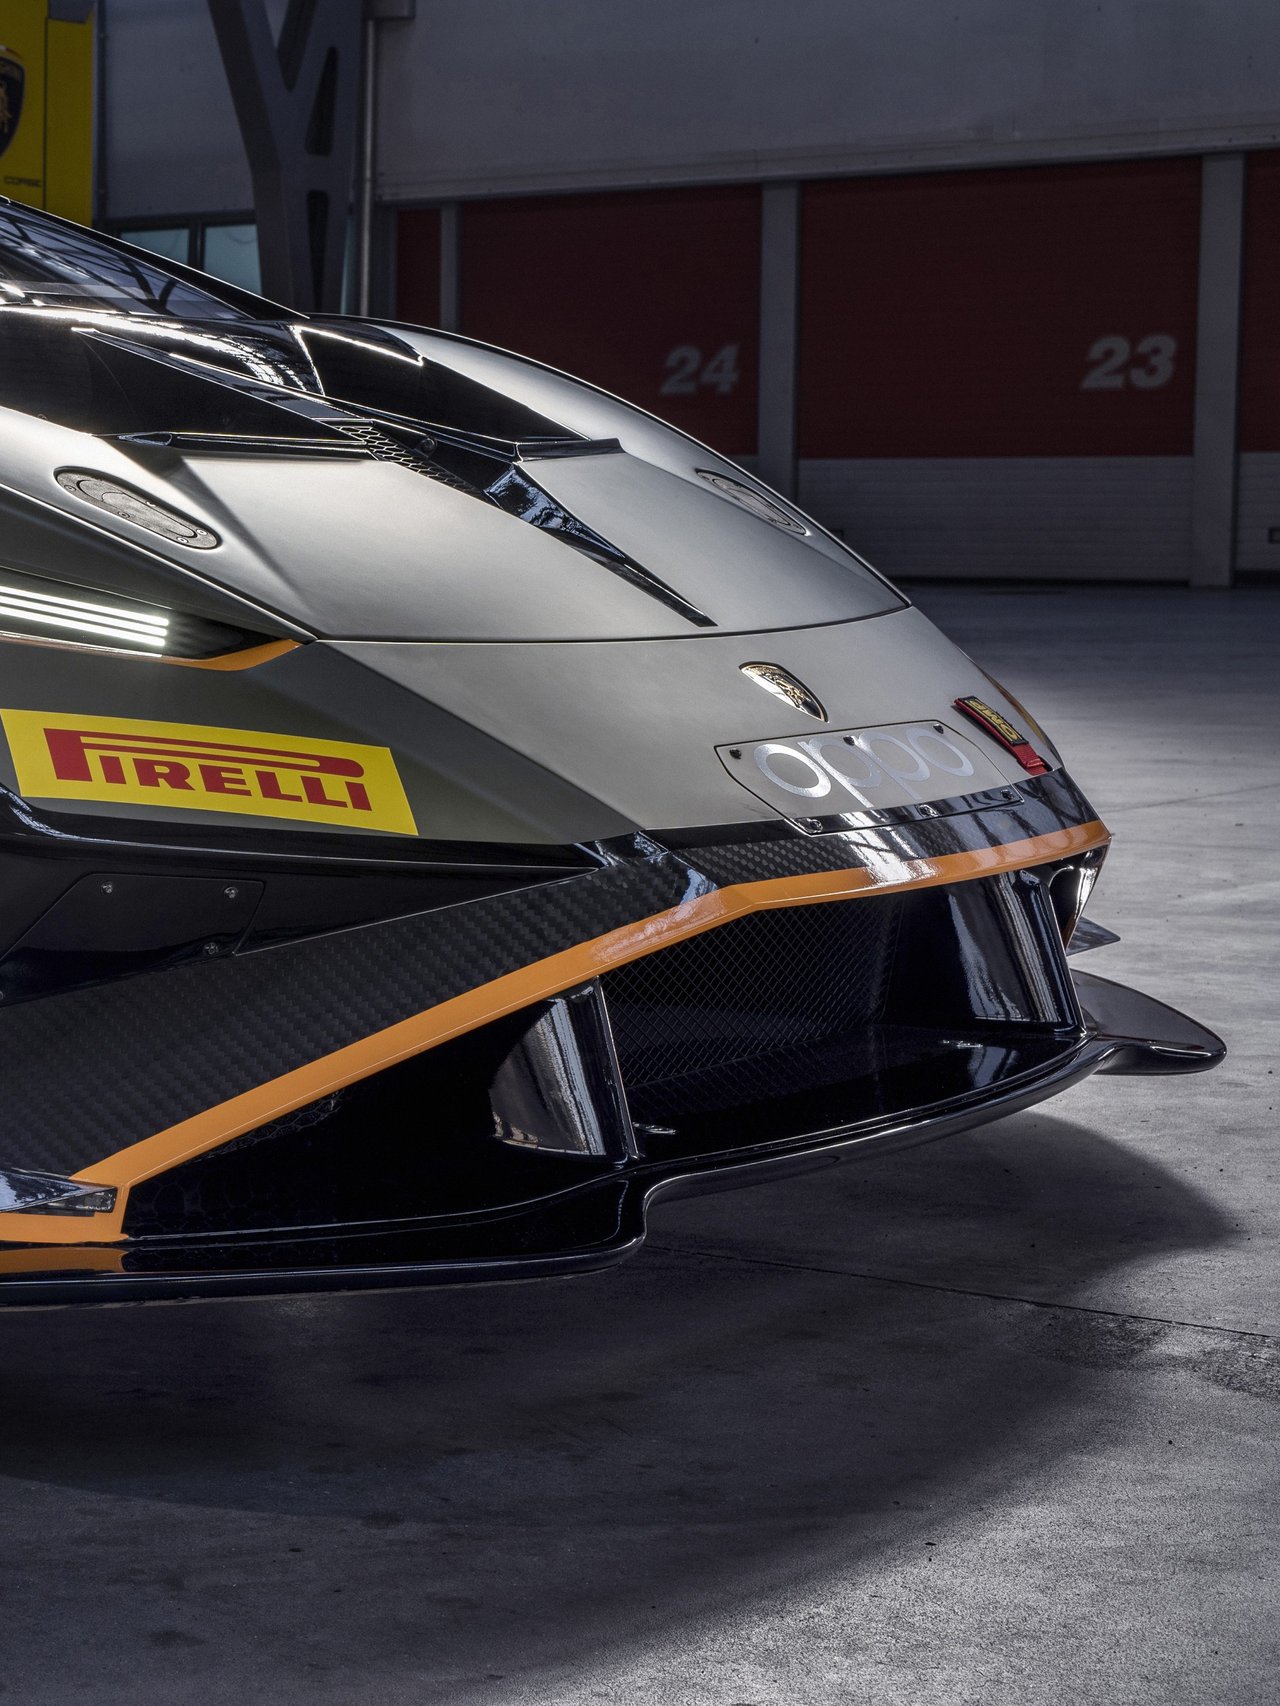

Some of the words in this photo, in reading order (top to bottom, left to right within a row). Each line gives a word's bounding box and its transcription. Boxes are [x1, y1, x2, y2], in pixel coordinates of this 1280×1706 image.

[660, 343, 740, 395] 24
[1081, 334, 1178, 390] 23
[969, 700, 1019, 741] OMP
[43, 727, 373, 812] PIRELLI
[753, 726, 975, 808] oppo
